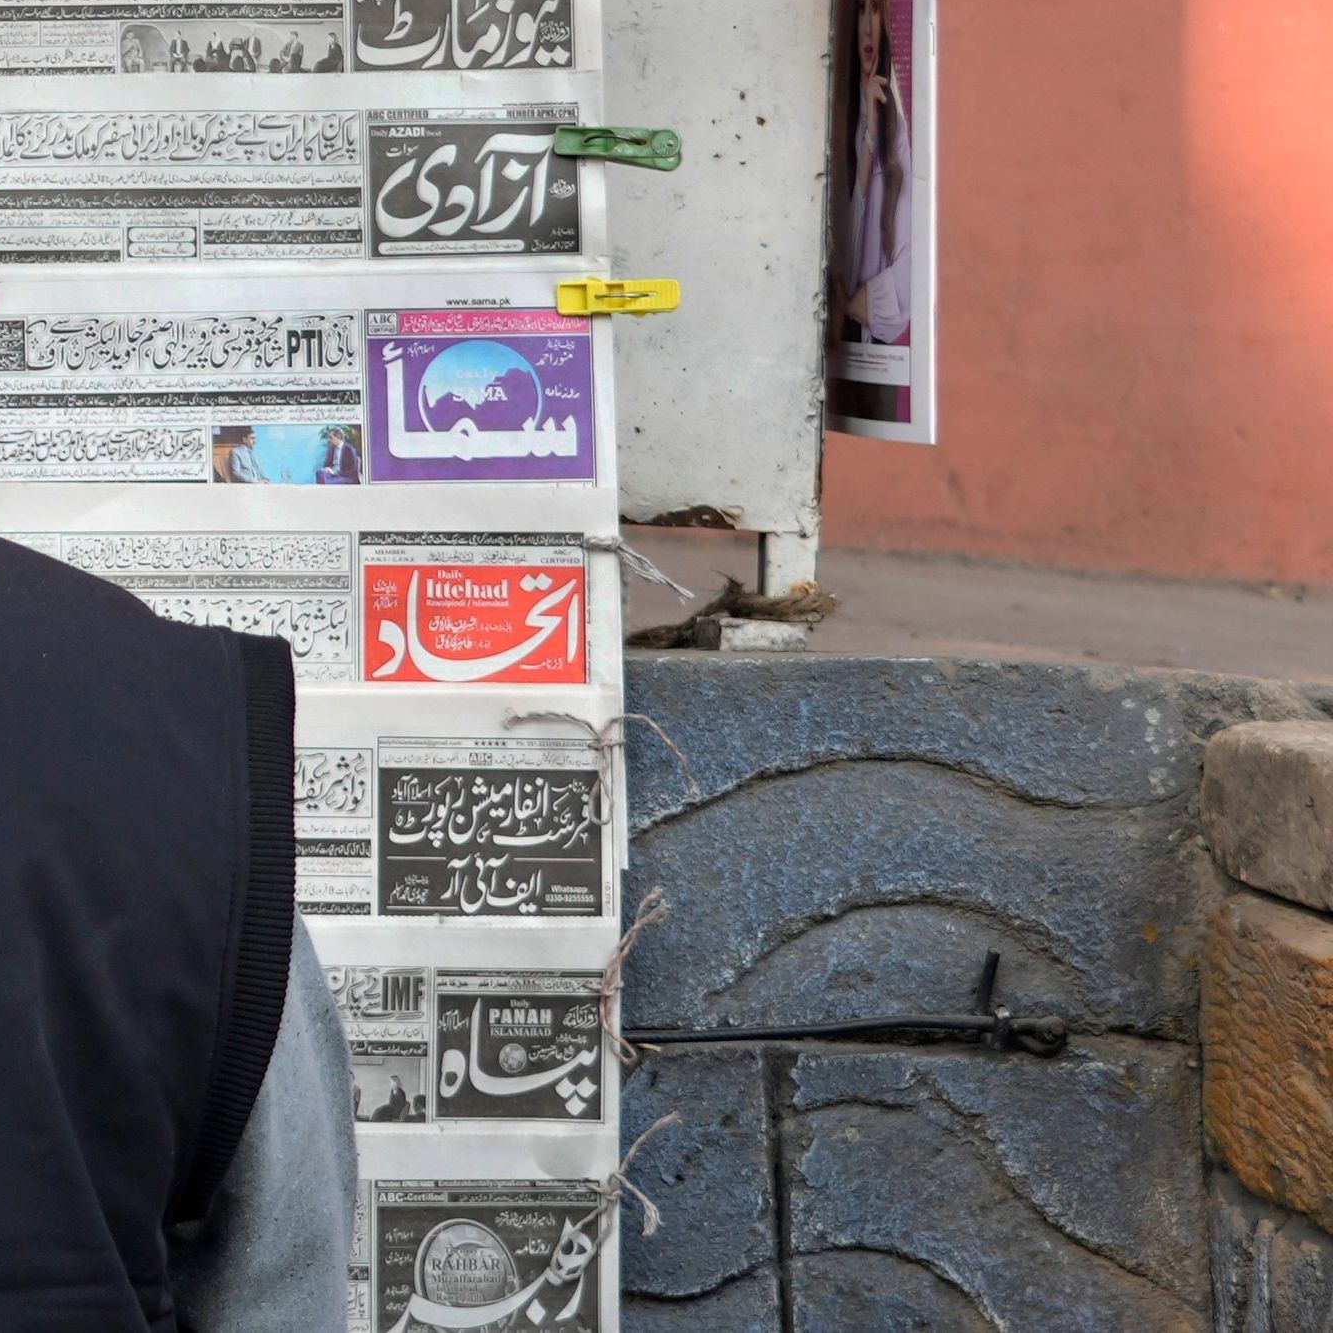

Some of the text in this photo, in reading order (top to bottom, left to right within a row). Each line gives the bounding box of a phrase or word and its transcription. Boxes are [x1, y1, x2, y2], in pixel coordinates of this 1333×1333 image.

[389, 127, 425, 137] AZADI
[446, 297, 511, 307] www.sama.pk
[288, 329, 322, 364] PTI
[426, 580, 508, 598] Ittehad
[383, 976, 424, 1011] IMF
[489, 1009, 552, 1024] PANAH
[490, 1027, 551, 1037] ISLAMABAD
